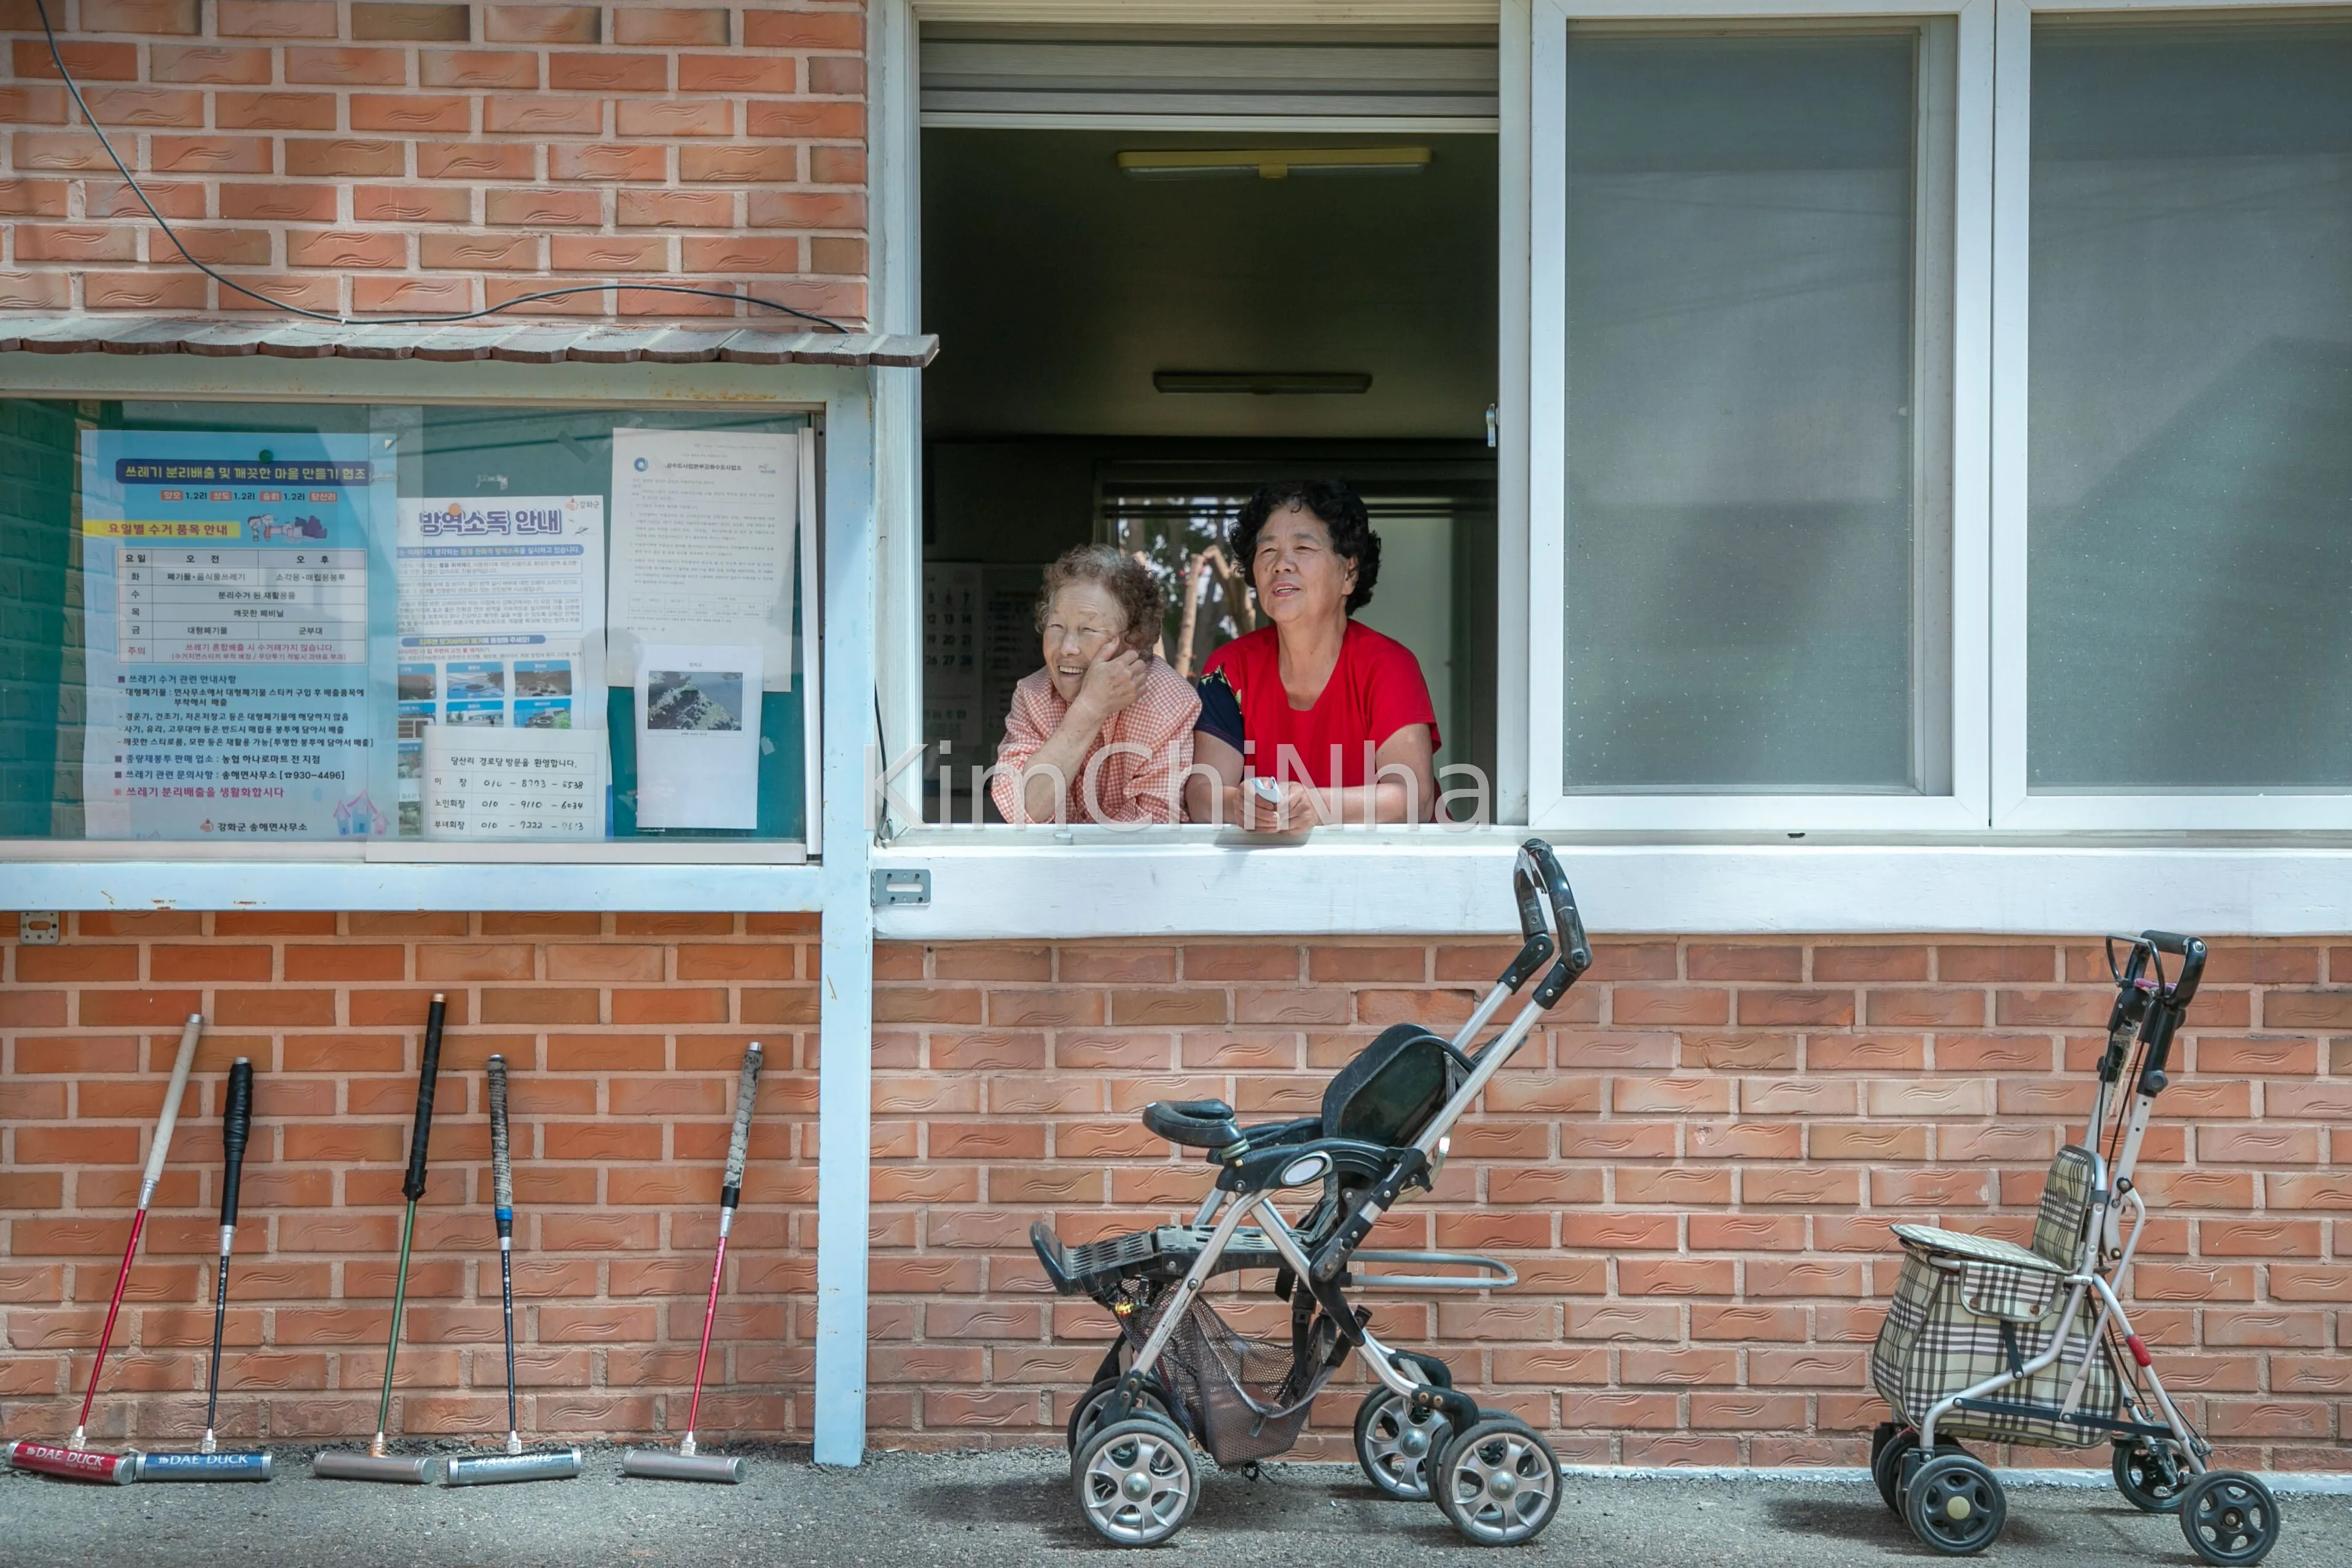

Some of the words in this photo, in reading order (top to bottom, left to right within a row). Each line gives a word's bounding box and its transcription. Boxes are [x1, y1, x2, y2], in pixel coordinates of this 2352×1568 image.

[125, 466, 162, 478] 쓰레기
[166, 466, 214, 479] 분리배출
[219, 467, 230, 479] 및
[234, 468, 271, 480] 깨끗한
[275, 468, 299, 480] 마을
[302, 468, 338, 480] 만들기
[342, 468, 366, 480] 협조
[419, 510, 509, 536] 방역소독
[515, 509, 562, 535] 안내
[108, 523, 144, 535] 요일별
[149, 524, 172, 535] 수거
[177, 524, 200, 535] 품목
[204, 525, 227, 536] 안내
[131, 573, 139, 581] 화
[131, 590, 140, 599] 수
[218, 591, 250, 600] 분리수거
[264, 591, 296, 600] 재활용품
[131, 608, 140, 616] 목
[234, 610, 257, 618] 깨끗한
[261, 610, 284, 618] 폐비닐
[131, 625, 140, 635] 금
[187, 627, 227, 635] 대형폐기물
[299, 627, 323, 635] 군부대
[128, 646, 146, 656] 주의
[129, 675, 155, 684] 쓰레기
[159, 675, 176, 684] 수거
[179, 675, 199, 684] 관련
[200, 675, 236, 684] 안내사항
[125, 688, 166, 697] 대형폐기물
[174, 688, 223, 697] 면사무소에서
[226, 688, 265, 697] 대형폐기물
[269, 688, 292, 697] 스티커
[295, 688, 311, 697] 구입
[314, 688, 321, 697] 후
[324, 688, 364, 697] 배출품목에
[174, 698, 206, 707] 부착해서
[211, 698, 227, 707] 배출
[156, 713, 183, 721] 건조기,
[186, 713, 226, 721] 저온저장고
[229, 713, 245, 721] 등은
[248, 713, 296, 721] 대형폐기물에
[299, 713, 331, 721] 해당하지
[333, 713, 349, 721] 않음
[124, 726, 144, 734] 사기,
[146, 726, 165, 734] 유리,
[168, 726, 200, 734] 고무대야
[203, 726, 219, 734] 등은
[222, 726, 246, 734] 반드시
[276, 726, 299, 734] 봉투에
[302, 726, 326, 734] 담아서
[328, 726, 344, 734] 배출
[123, 738, 147, 747] 깨끗한
[207, 738, 223, 747] 등은
[226, 738, 250, 747] 재활용
[300, 738, 325, 747] 봉투에
[327, 738, 351, 747] 담아서
[126, 755, 172, 764] 종량제봉투
[174, 755, 193, 764] 판매
[195, 755, 213, 764] 업소
[222, 755, 240, 764] 농협
[243, 755, 288, 764] 하나로마트
[291, 755, 300, 764] 전
[303, 755, 320, 764] 지점
[452, 757, 474, 766] 당산리
[479, 757, 503, 767] 경로당
[506, 758, 529, 767] 방문을
[534, 759, 577, 768] 환영합니다.
[125, 770, 153, 780] 쓰레기
[156, 770, 174, 780] 관련
[177, 770, 213, 780] 문의사항
[222, 770, 276, 780] 송해면사무소
[127, 787, 158, 798] 쓰레기
[162, 787, 215, 798] 분리배출을
[220, 787, 284, 798] 생활화합시다
[435, 799, 465, 809] 노인회장
[218, 823, 246, 832] 강화군
[249, 823, 307, 832] 송해면사무소
[434, 821, 465, 830] 부녀회장
[35, 1447, 63, 1460] DAE
[67, 1452, 104, 1466] DUCK
[170, 1455, 200, 1465] DAE
[206, 1454, 248, 1464] DUCK
